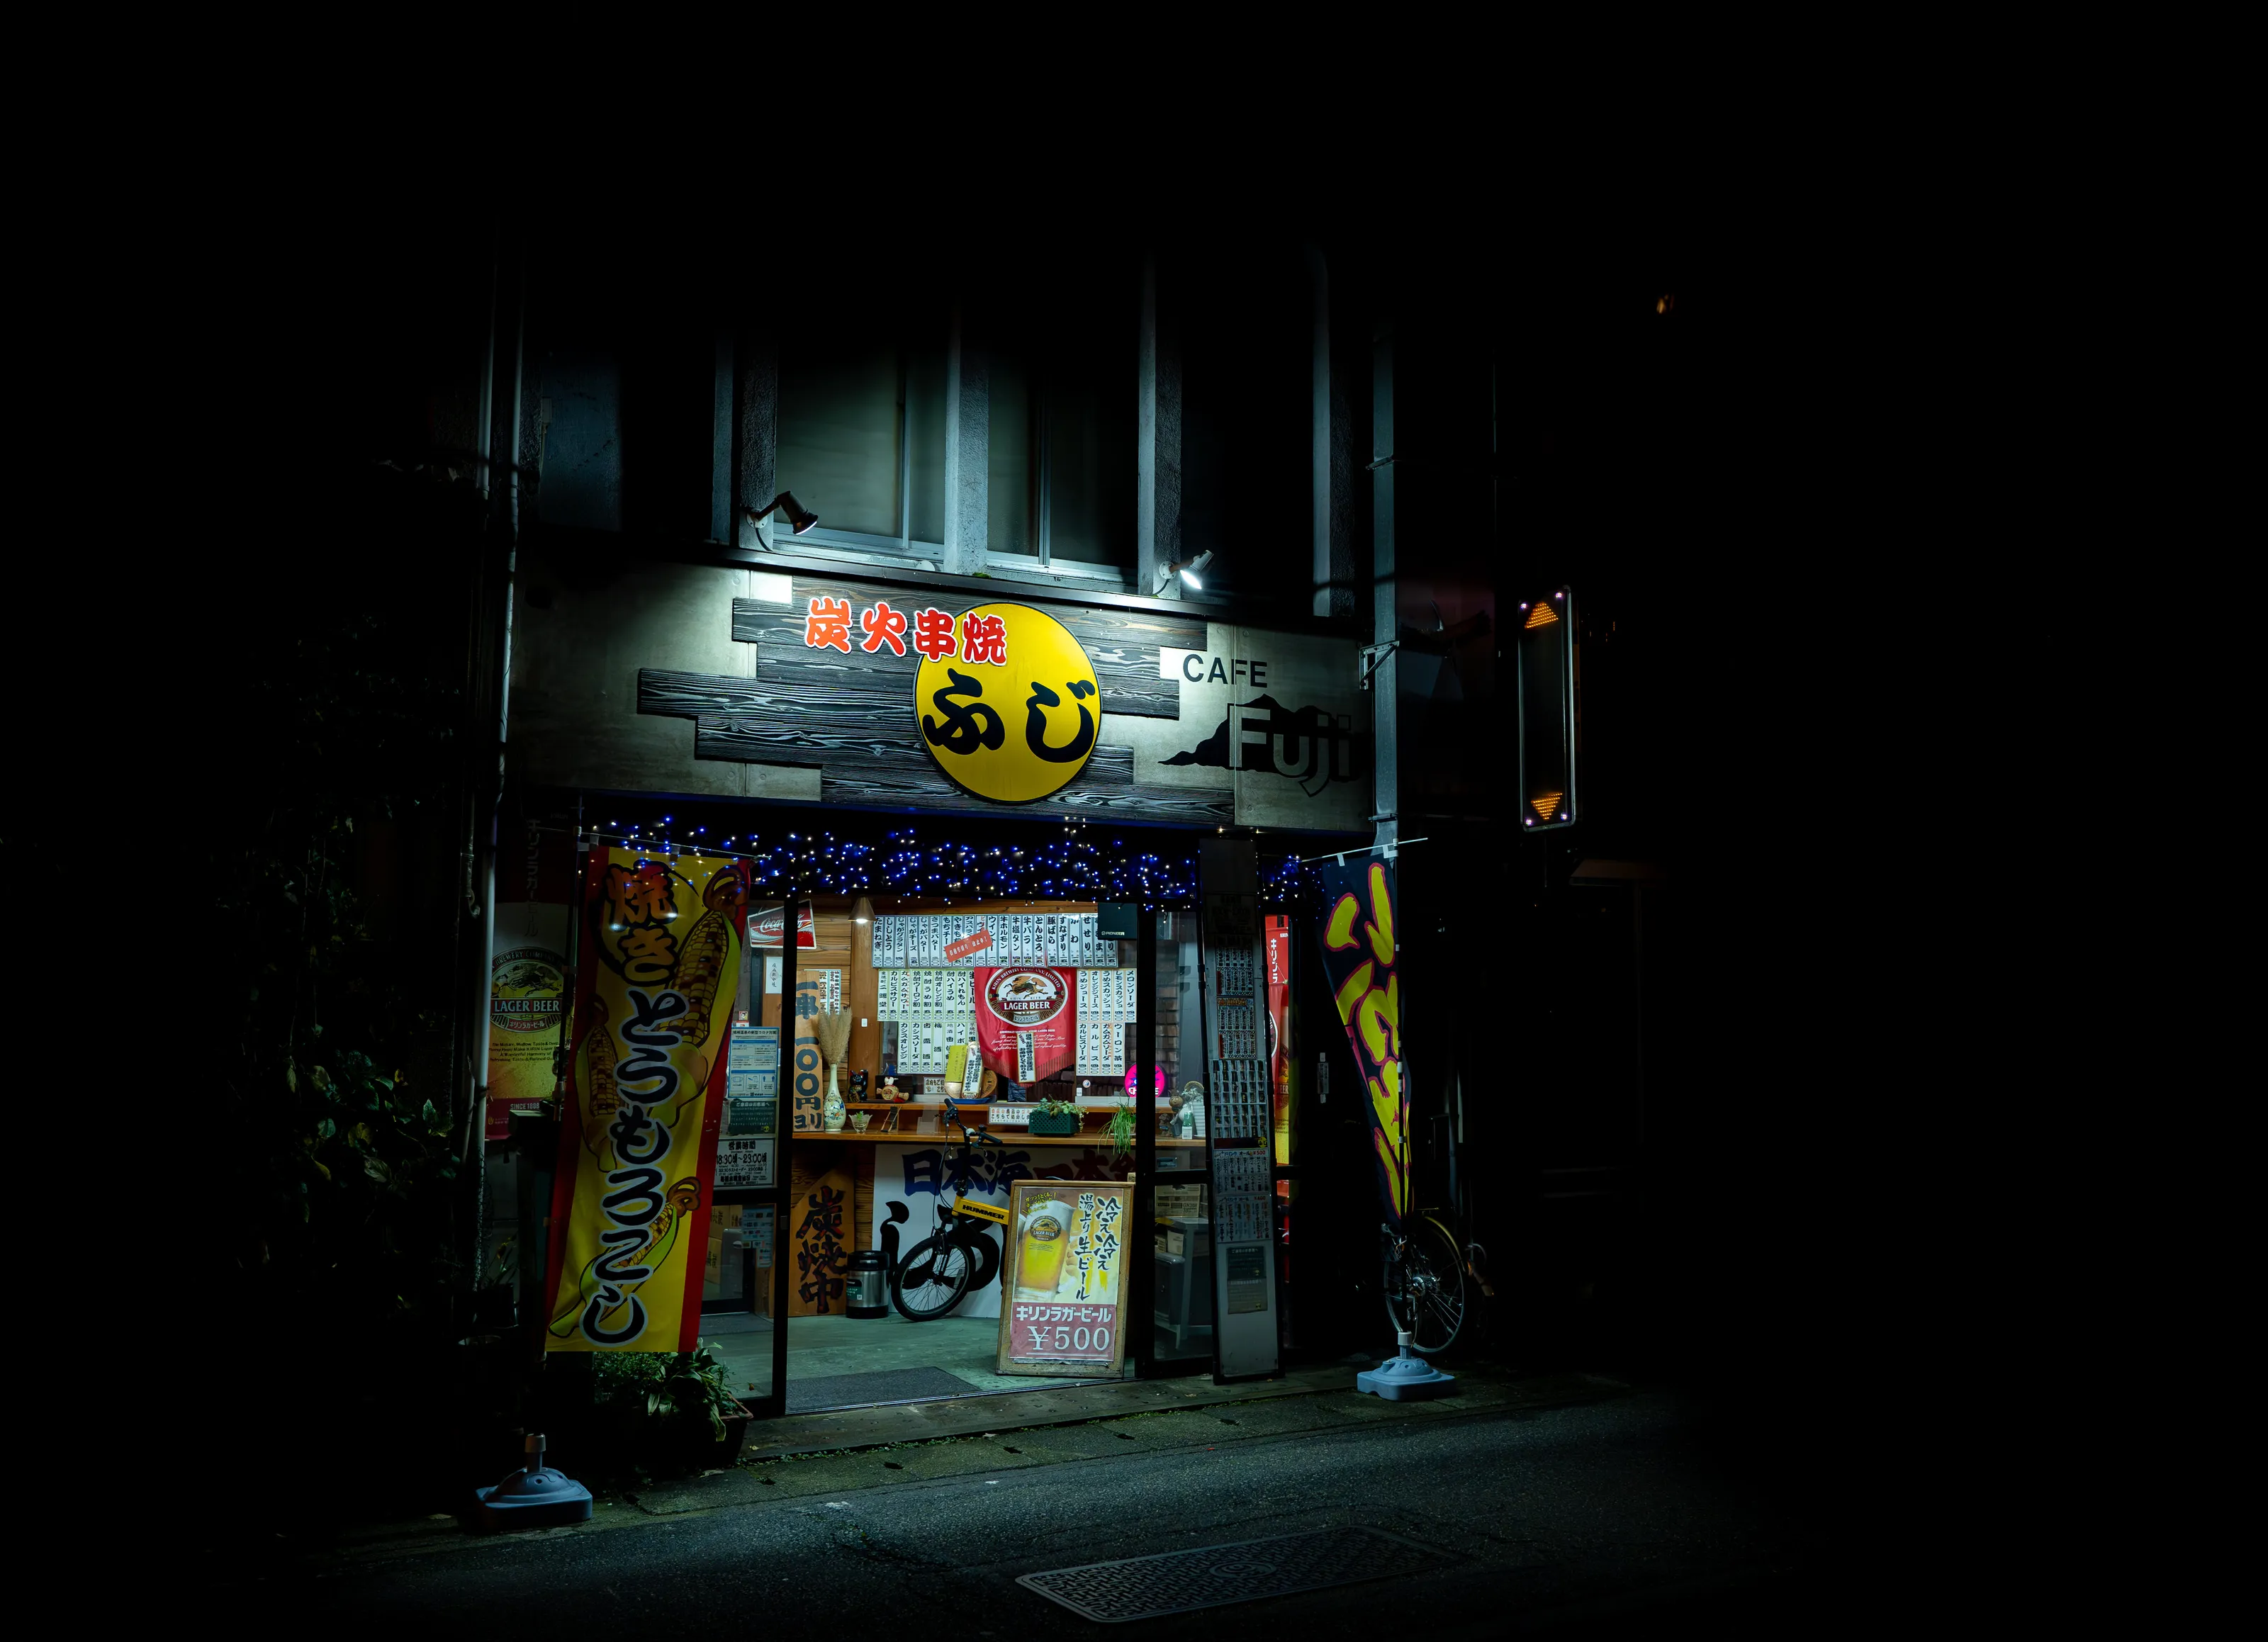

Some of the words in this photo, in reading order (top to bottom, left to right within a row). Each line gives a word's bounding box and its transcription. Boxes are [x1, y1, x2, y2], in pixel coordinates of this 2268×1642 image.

[804, 596, 1007, 666] 炭火串焼
[1182, 653, 1269, 688] CAFE
[921, 668, 1096, 764] ふじ
[1228, 702, 1354, 798] Fuji
[874, 917, 882, 949] たまねぎ
[885, 918, 893, 950] ししとう
[896, 916, 905, 952] じゃがグラタン
[909, 917, 917, 951] じゃがチーズ
[919, 917, 928, 952] じゃがバター
[931, 917, 940, 951] さつまバター
[942, 916, 950, 952] もちチー
[1023, 916, 1032, 944] 牛バラ
[1035, 916, 1043, 951] とんとろ
[1059, 916, 1067, 951] すなずり
[1083, 916, 1091, 951] せせり
[912, 971, 921, 1007] 焼酎ウーロン割
[924, 971, 932, 1007] 焼酎うめ割
[934, 971, 943, 1007] 焼酎オレンジ割
[946, 971, 955, 1001] 酎ハイうめ
[958, 971, 966, 1006] 酎ハイれもん
[1079, 971, 1088, 1008] うめジュース
[1102, 971, 1111, 1008] うめスカッシュ
[1127, 971, 1135, 1008] メロンソーダ
[498, 1001, 534, 1012] LAGER
[533, 1000, 561, 1012] BEER
[1004, 1001, 1028, 1011] LAGER
[1028, 1001, 1050, 1010] BEER
[911, 1023, 920, 1059] カシスソーダ
[1114, 1023, 1123, 1061] ウーロン茶
[581, 860, 687, 1344] 焼きとうもろこし
[728, 1140, 756, 1150] 営業時間
[962, 1204, 1005, 1220] HUMMER
[1074, 1193, 1095, 1301] 湯上り生ビール
[1096, 1196, 1122, 1271] 冷え冷え
[1016, 1305, 1113, 1323] キリンラガービール
[1026, 1325, 1110, 1351] ¥500
